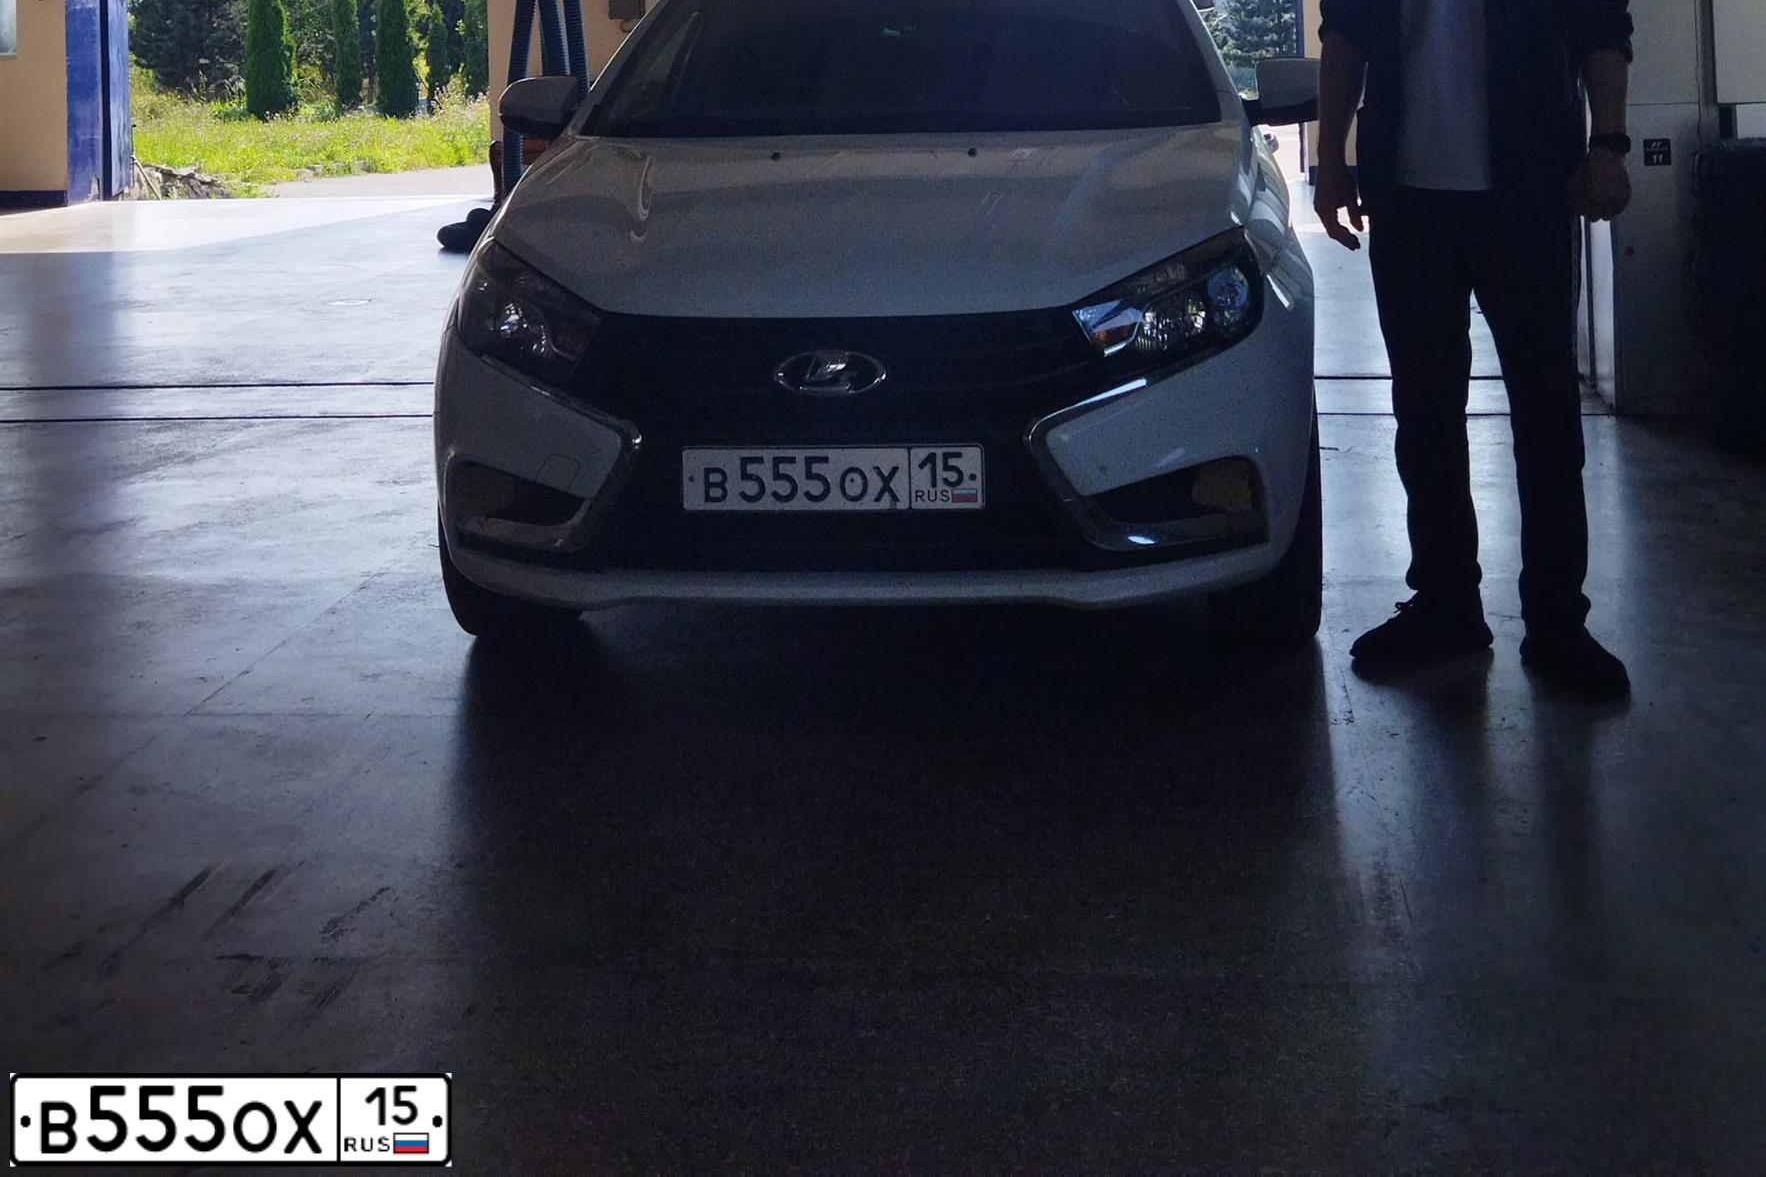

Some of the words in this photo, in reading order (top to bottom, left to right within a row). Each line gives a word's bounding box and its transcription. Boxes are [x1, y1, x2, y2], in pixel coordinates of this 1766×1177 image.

[1652, 153, 1663, 164] 11
[917, 452, 964, 488] 15
[915, 490, 950, 503] RUS
